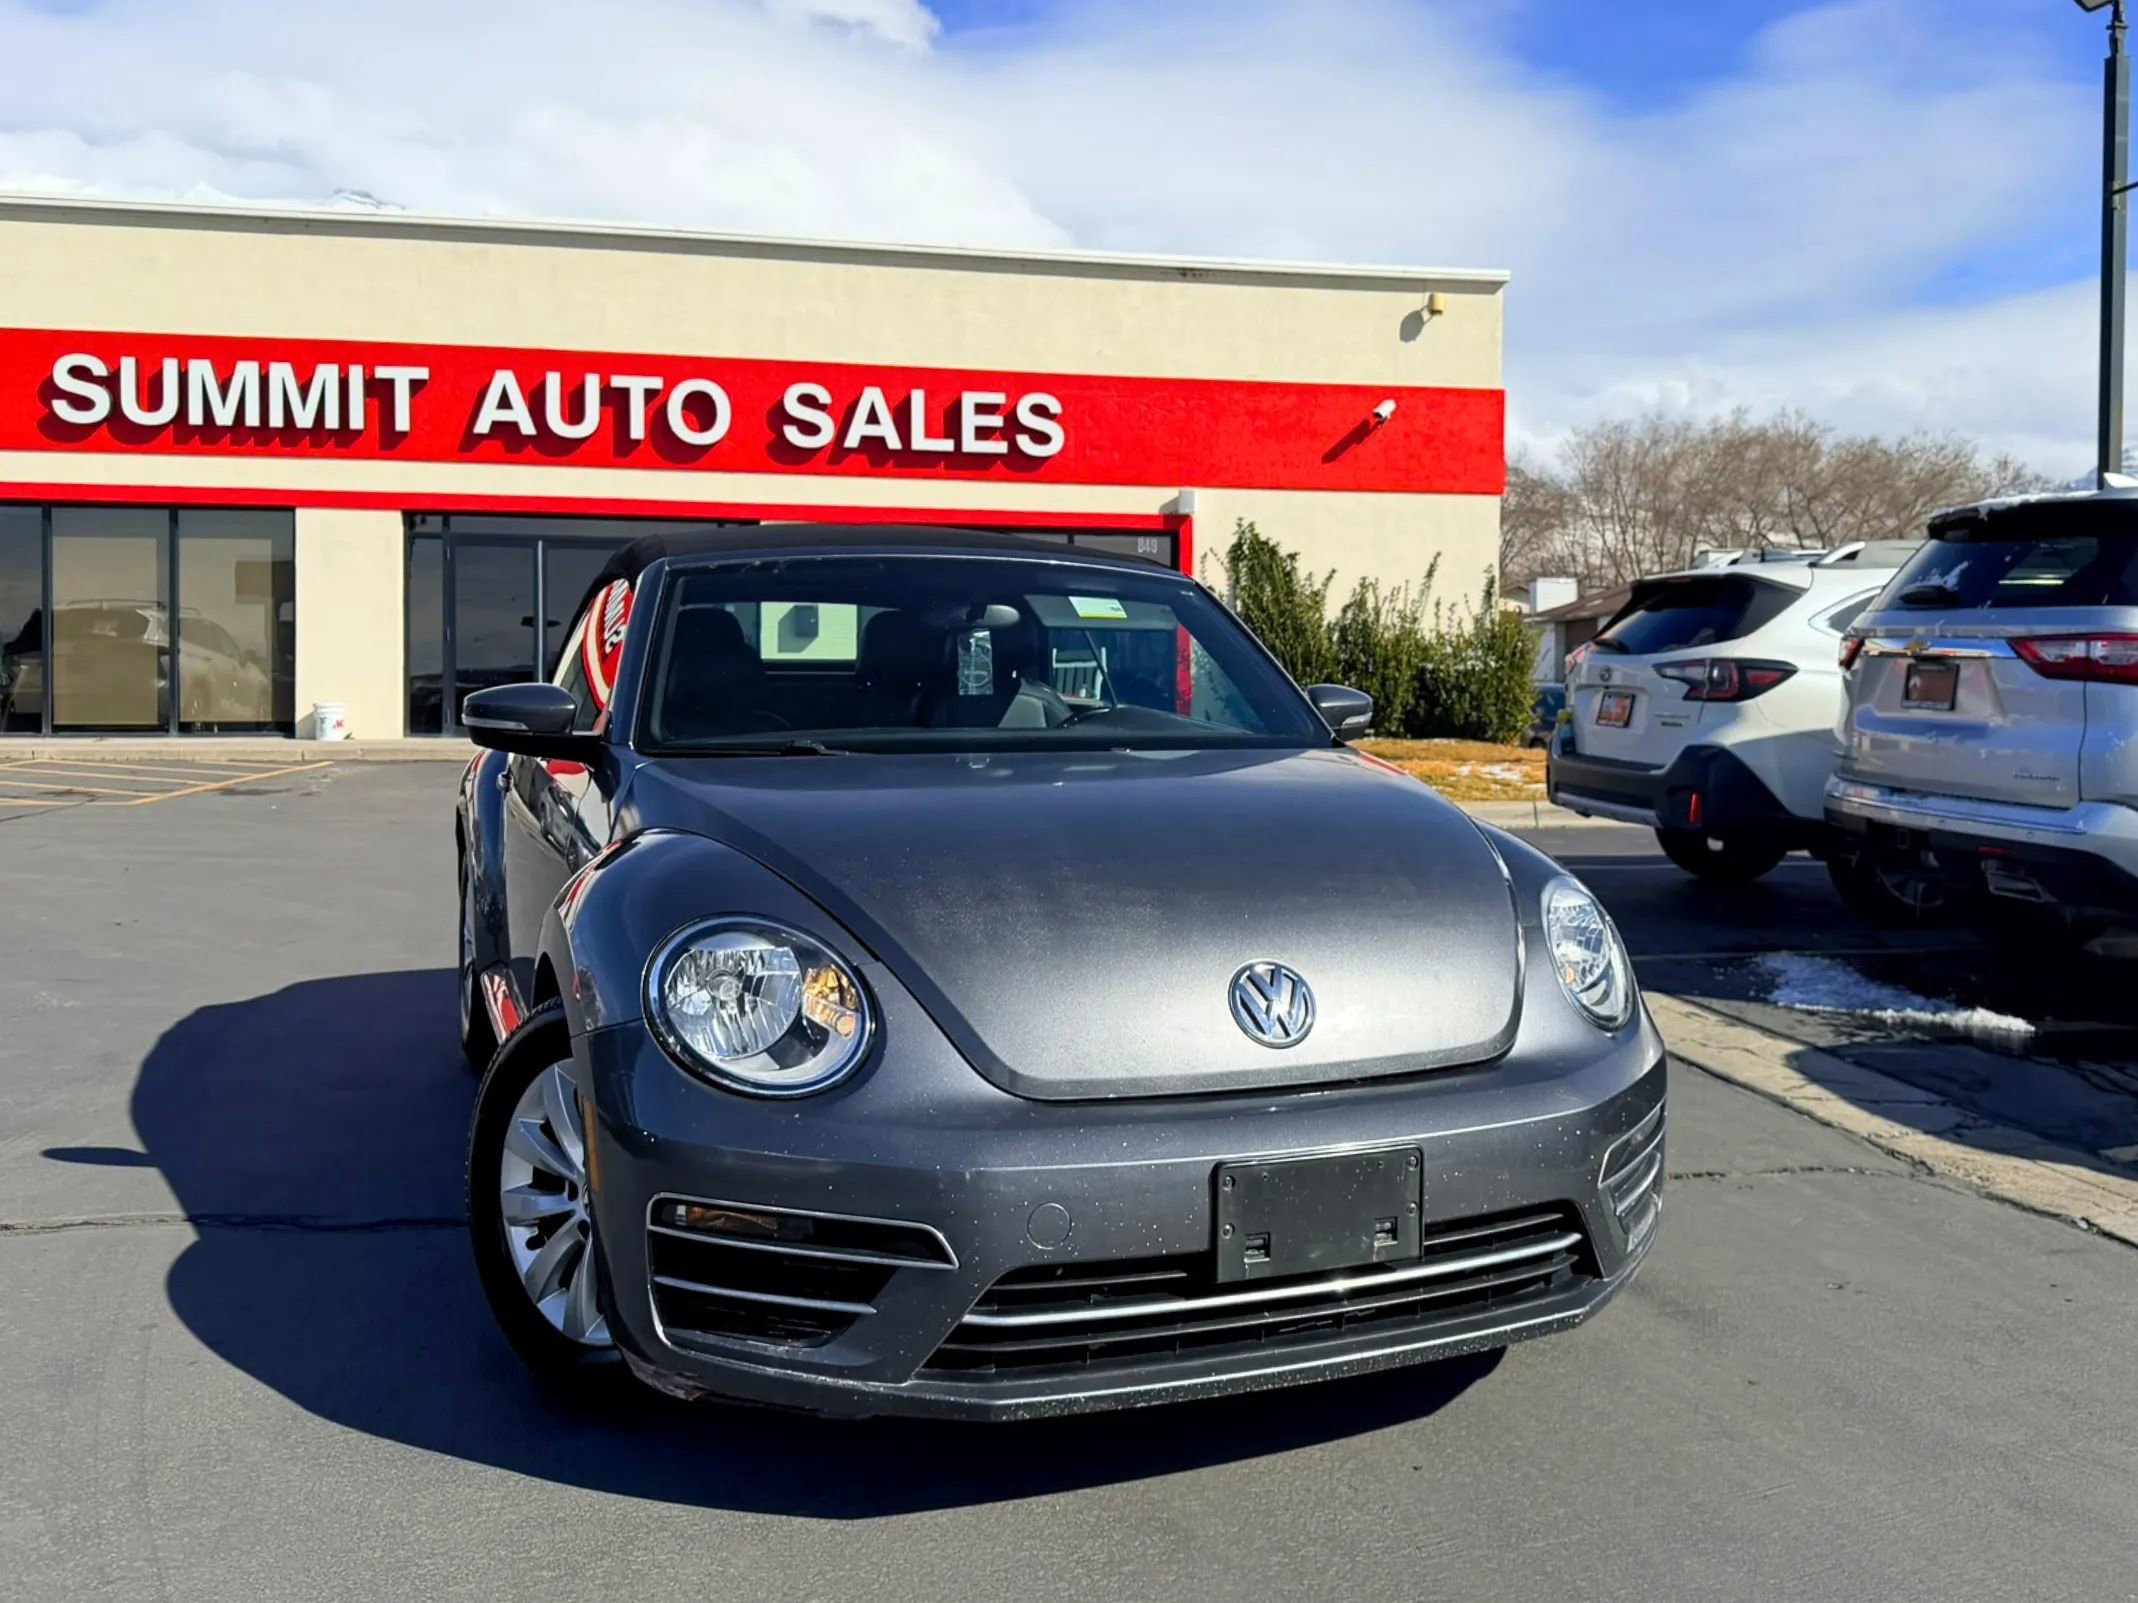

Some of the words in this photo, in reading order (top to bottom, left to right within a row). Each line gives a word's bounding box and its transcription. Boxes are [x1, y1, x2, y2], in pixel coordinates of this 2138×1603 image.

[51, 352, 430, 433] SUMMIT
[473, 368, 732, 446] AUTO
[782, 382, 1066, 458] SALES
